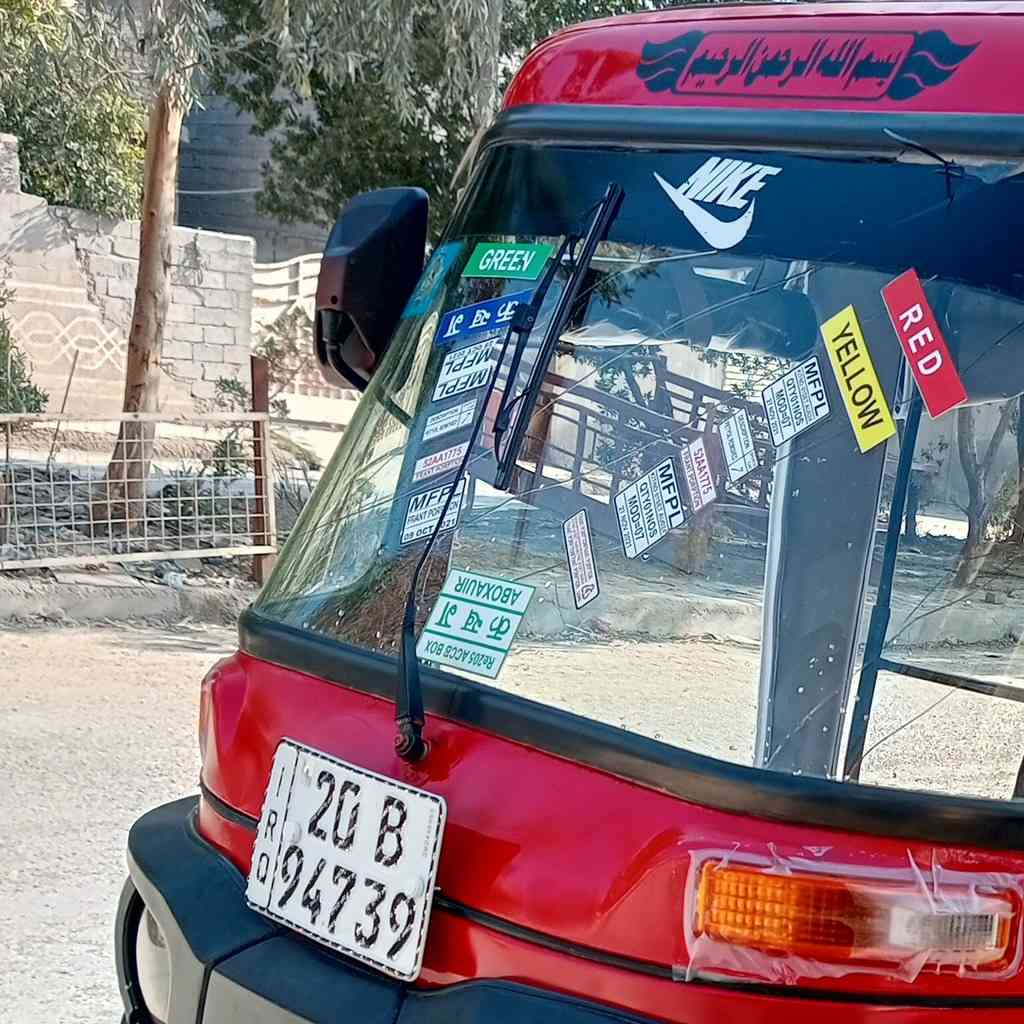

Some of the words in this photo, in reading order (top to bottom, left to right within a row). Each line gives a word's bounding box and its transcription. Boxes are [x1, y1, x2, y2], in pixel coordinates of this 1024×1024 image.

[678, 156, 783, 209] NIKE
[478, 248, 536, 272] GREEN
[444, 348, 493, 374] MFPL
[898, 303, 943, 376] RED
[439, 370, 487, 398] MFPL
[803, 360, 828, 417] MFPL
[831, 321, 884, 431] YELLOW
[776, 389, 791, 429] MOD=07
[638, 481, 658, 538] QTY01NOS
[658, 462, 684, 525] MFPL
[416, 525, 434, 536] OCT
[627, 495, 645, 542] MOD=07
[455, 575, 522, 606] ABOXAUIR
[435, 601, 458, 629] ग
[424, 639, 443, 656] BOX
[308, 769, 361, 850] 20
[374, 795, 409, 867] B
[278, 845, 416, 960] 94739
